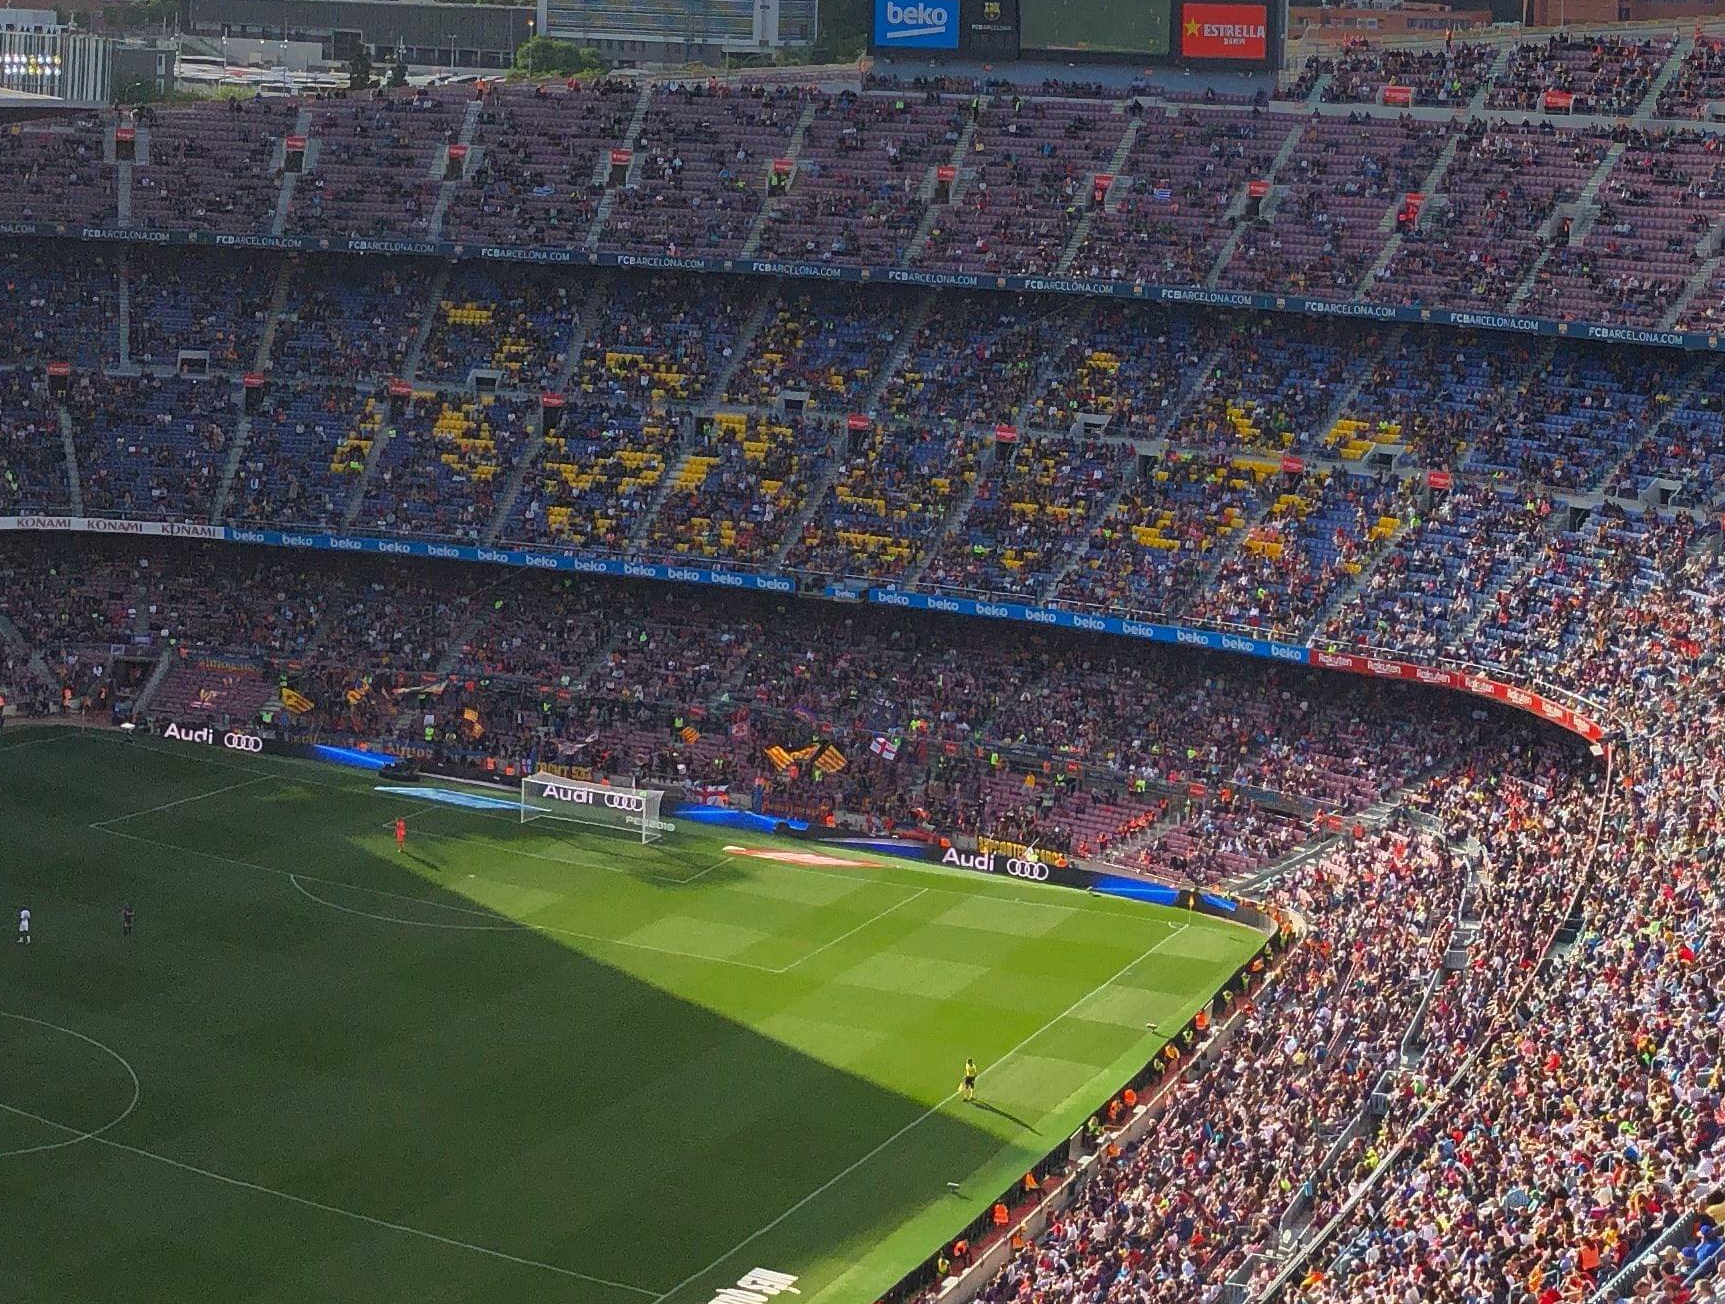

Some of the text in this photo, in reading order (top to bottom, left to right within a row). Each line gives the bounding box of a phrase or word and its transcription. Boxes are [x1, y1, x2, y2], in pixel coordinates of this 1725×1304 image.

[887, 1, 948, 25] beko
[1204, 24, 1265, 38] ESTRELLA
[83, 228, 170, 242] FCBARCELONA.COM
[216, 235, 302, 248] FCBARCELONA.COM
[349, 240, 434, 253] FCBARCELONA.COM
[481, 248, 569, 262] FCBARCELONA.COM
[618, 255, 704, 269] FCBARCELONA.COM
[753, 262, 840, 277] FCBARCELONA.COM
[889, 270, 977, 285] FCBARCELONA.COM
[1025, 279, 1113, 293] FCBARCELONA.COM
[1162, 289, 1251, 305] FCBARCELONA.COM
[1305, 301, 1396, 317] FCBARCELONA.COM
[1451, 315, 1539, 330] FCBARCELONA.COM
[1589, 327, 1683, 345] FCBARCELONA.COM
[17, 517, 72, 529] KONAMI
[87, 518, 144, 533] KONAMI
[161, 524, 217, 538] KONAMI
[233, 529, 264, 542] beko
[282, 533, 314, 547] beko
[330, 536, 362, 550] beko
[378, 540, 410, 554] beko
[427, 544, 459, 558] beko
[477, 548, 509, 563] beko
[526, 553, 557, 568] beko
[574, 557, 606, 573] beko
[624, 562, 656, 577] beko
[667, 566, 699, 581] beko
[711, 571, 743, 586] beko
[757, 575, 790, 591] beko
[878, 589, 910, 606] beko
[927, 595, 959, 612] beko
[976, 601, 1008, 617] beko
[1025, 607, 1056, 623] beko
[1073, 614, 1105, 631] beko
[1122, 621, 1154, 637] beko
[1176, 629, 1209, 645] beko
[1222, 637, 1255, 653] beko
[1271, 644, 1302, 660] beko
[1318, 653, 1351, 667] Rakuten
[1367, 660, 1402, 675] Rakuten
[164, 722, 213, 745] Audi
[542, 783, 594, 805] Audi
[942, 847, 996, 871] Audi
